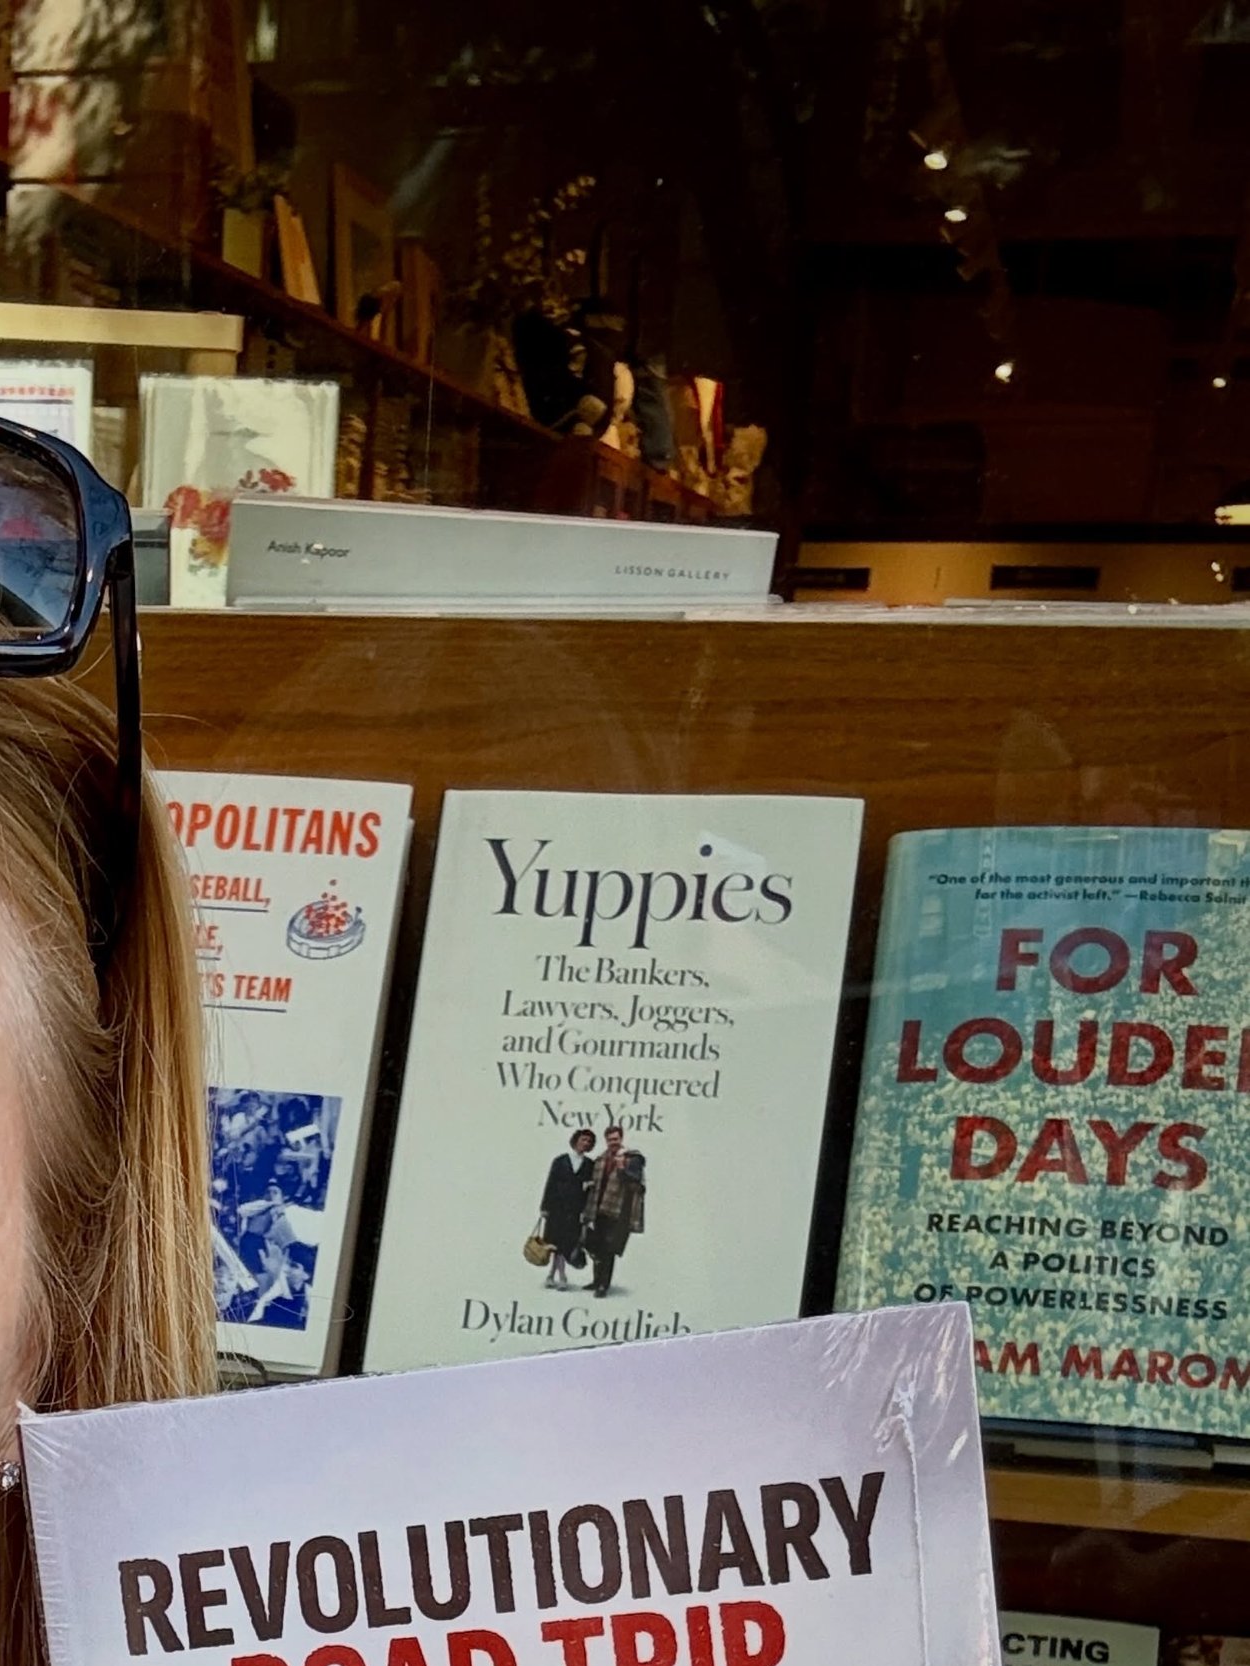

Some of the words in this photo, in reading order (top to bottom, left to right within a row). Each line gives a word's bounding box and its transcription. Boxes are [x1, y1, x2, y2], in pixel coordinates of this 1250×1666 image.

[615, 565, 662, 577] LISSON
[667, 568, 729, 580] GALLERY
[485, 838, 792, 949] Yuppies
[970, 871, 986, 884] of
[989, 871, 1011, 884] the
[1015, 873, 1051, 884] most
[1055, 874, 1124, 886] generous
[1128, 873, 1157, 885] and
[1162, 873, 1235, 888] important
[975, 887, 997, 900] for
[1001, 887, 1023, 900] the
[1027, 888, 1079, 900] activist
[536, 955, 590, 983] The
[996, 927, 1200, 996] FOR
[234, 974, 292, 1003] TEAM
[621, 995, 735, 1031] Joggers,
[502, 1029, 552, 1054] and
[558, 1027, 720, 1061] Gourmands
[496, 1061, 561, 1092] Who
[568, 1065, 720, 1102] Conquered
[537, 1100, 600, 1128] New
[603, 1102, 664, 1132] York
[950, 1115, 1208, 1191] DAYS
[927, 1212, 1088, 1239] REACHING
[1100, 1219, 1229, 1248] BEYOND
[989, 1251, 1009, 1271] A
[1023, 1251, 1156, 1279] POLITICS
[914, 1283, 954, 1302] OF
[965, 1285, 1229, 1320] POWERLESSNESS
[460, 1298, 552, 1343] Dylan
[118, 1472, 885, 1656] REVOLUTIONARY
[1002, 1632, 1110, 1665] CTING
